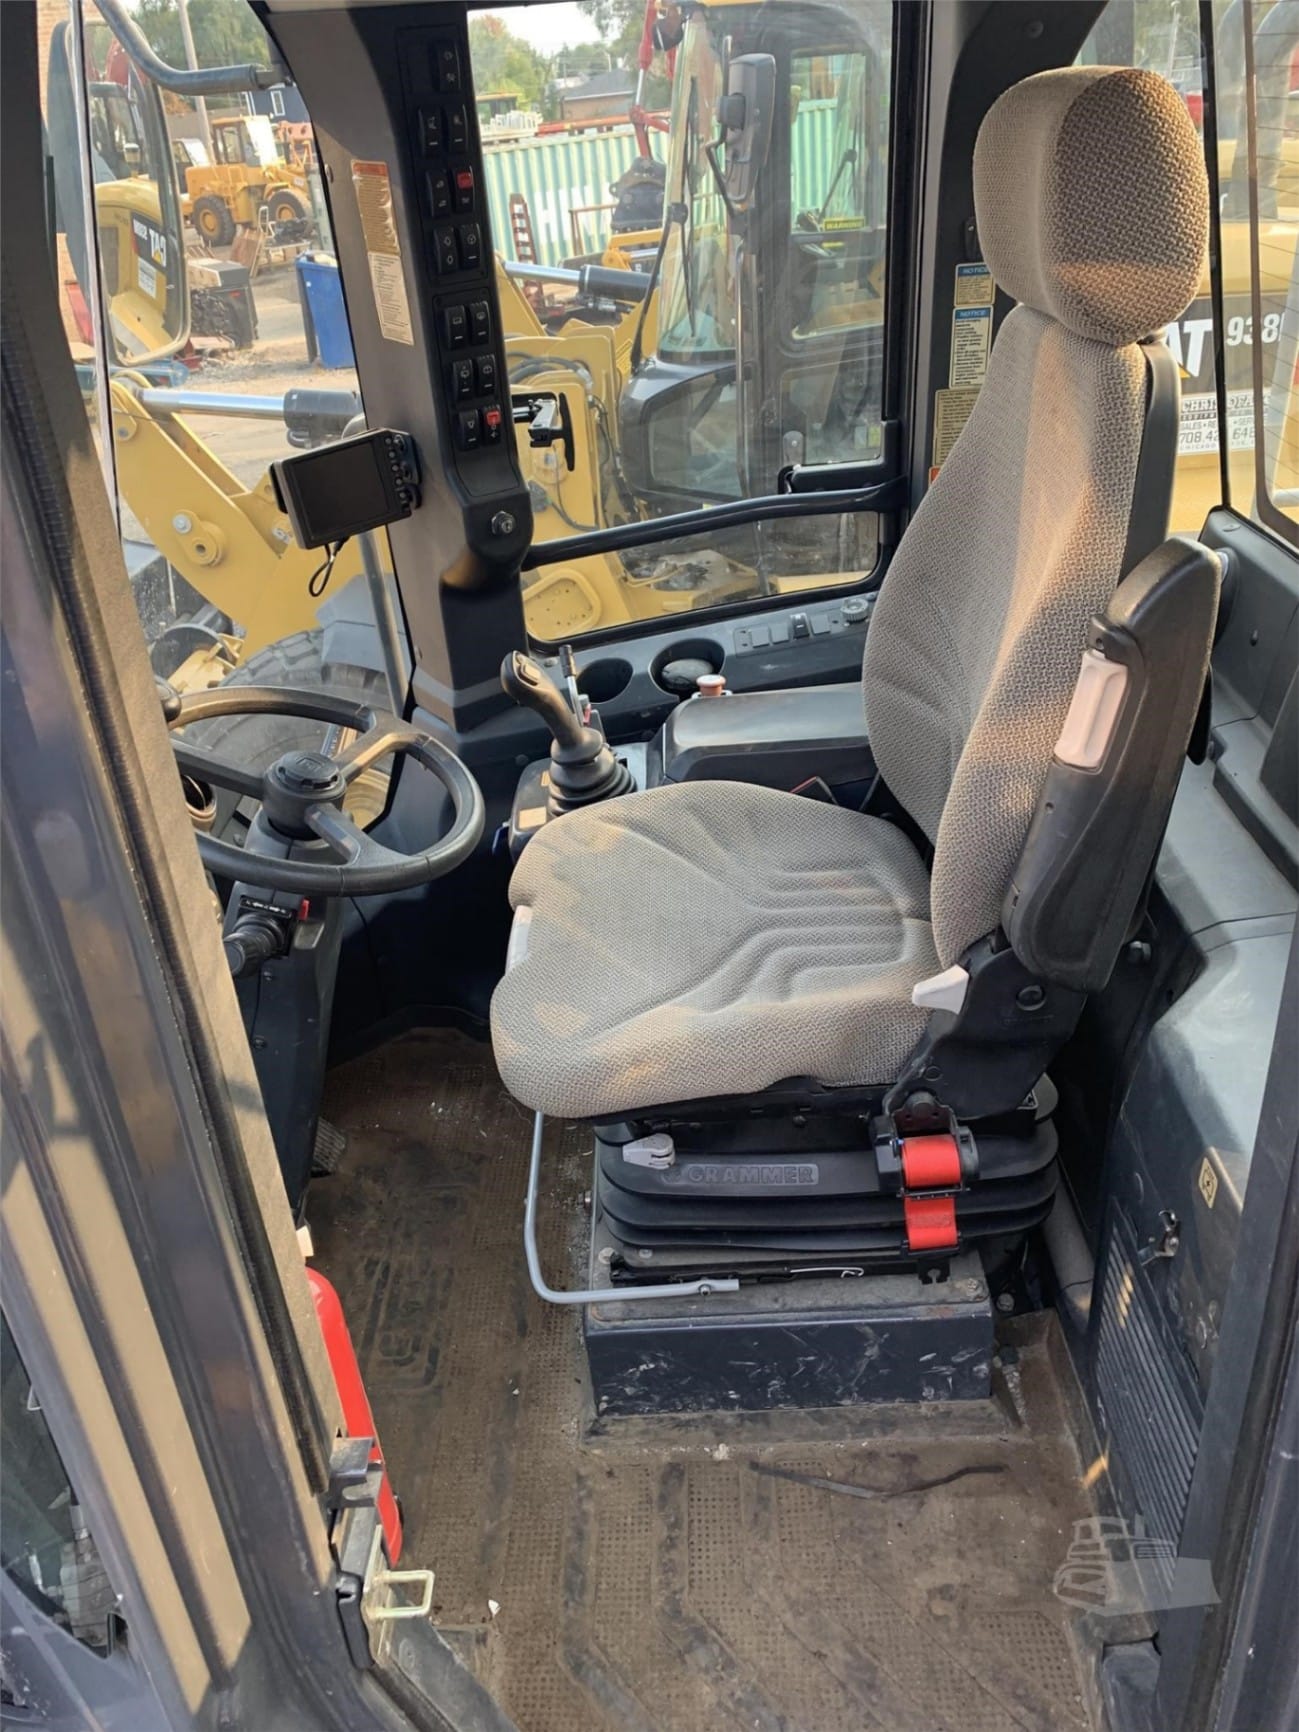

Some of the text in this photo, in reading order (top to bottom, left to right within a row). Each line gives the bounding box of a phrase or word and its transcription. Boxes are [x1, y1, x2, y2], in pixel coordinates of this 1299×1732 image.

[1164, 313, 1285, 378] AT 938
[688, 1166, 814, 1185] GRAMMER
